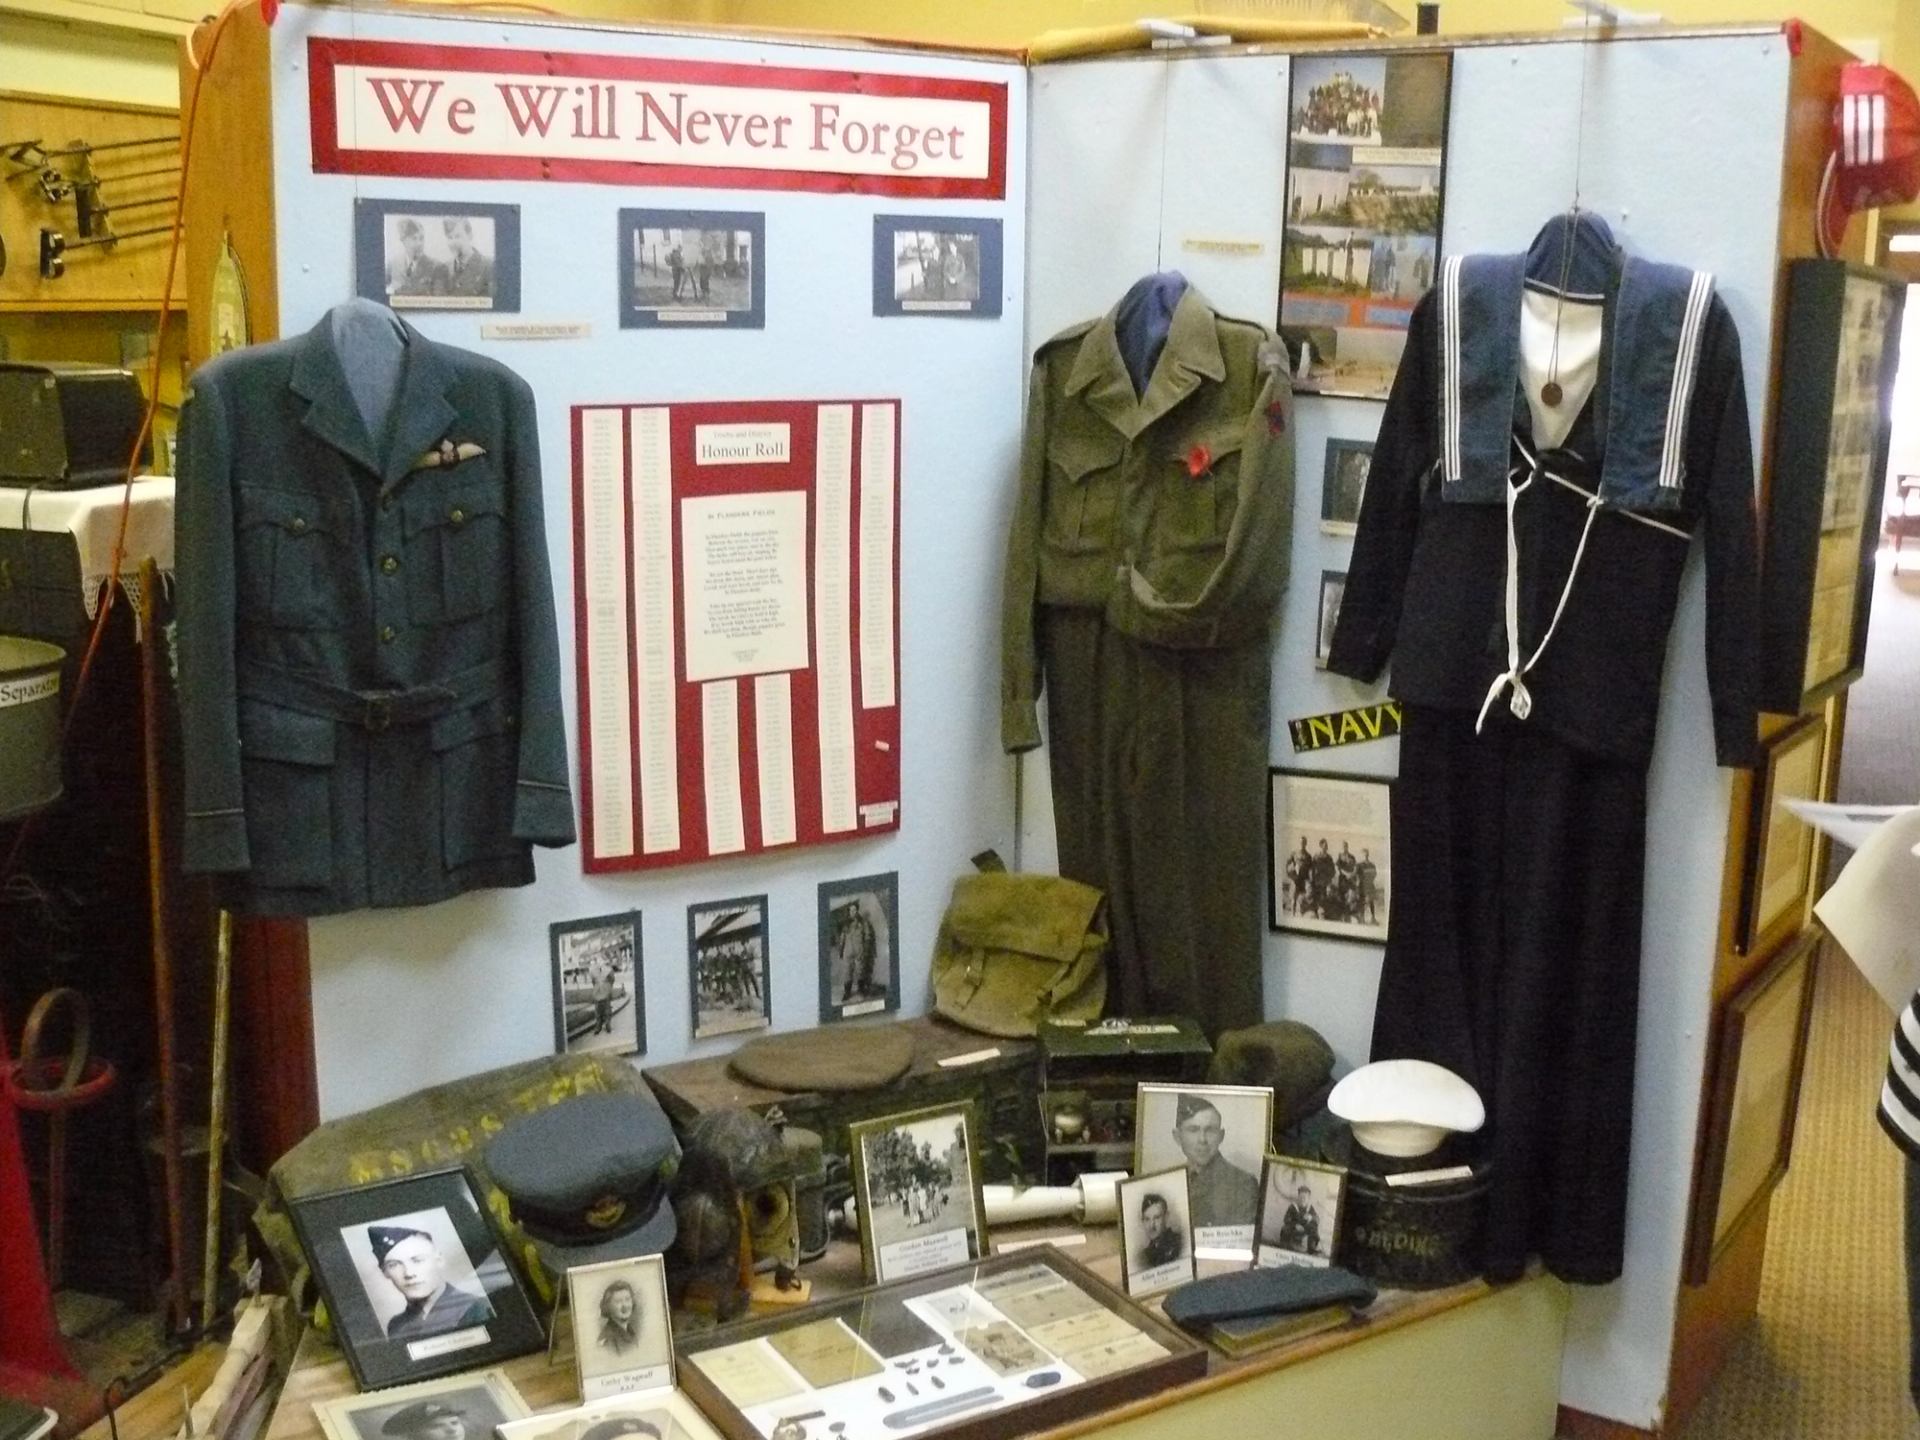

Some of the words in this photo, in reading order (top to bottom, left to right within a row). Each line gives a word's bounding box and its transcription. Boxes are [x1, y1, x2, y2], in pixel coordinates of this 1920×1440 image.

[366, 77, 477, 135] We
[494, 84, 621, 139] Will
[635, 91, 792, 149] Never
[809, 102, 965, 170] Forget
[702, 444, 750, 459] Honour
[755, 441, 783, 457] Roll
[1307, 703, 1402, 748] NAVY
